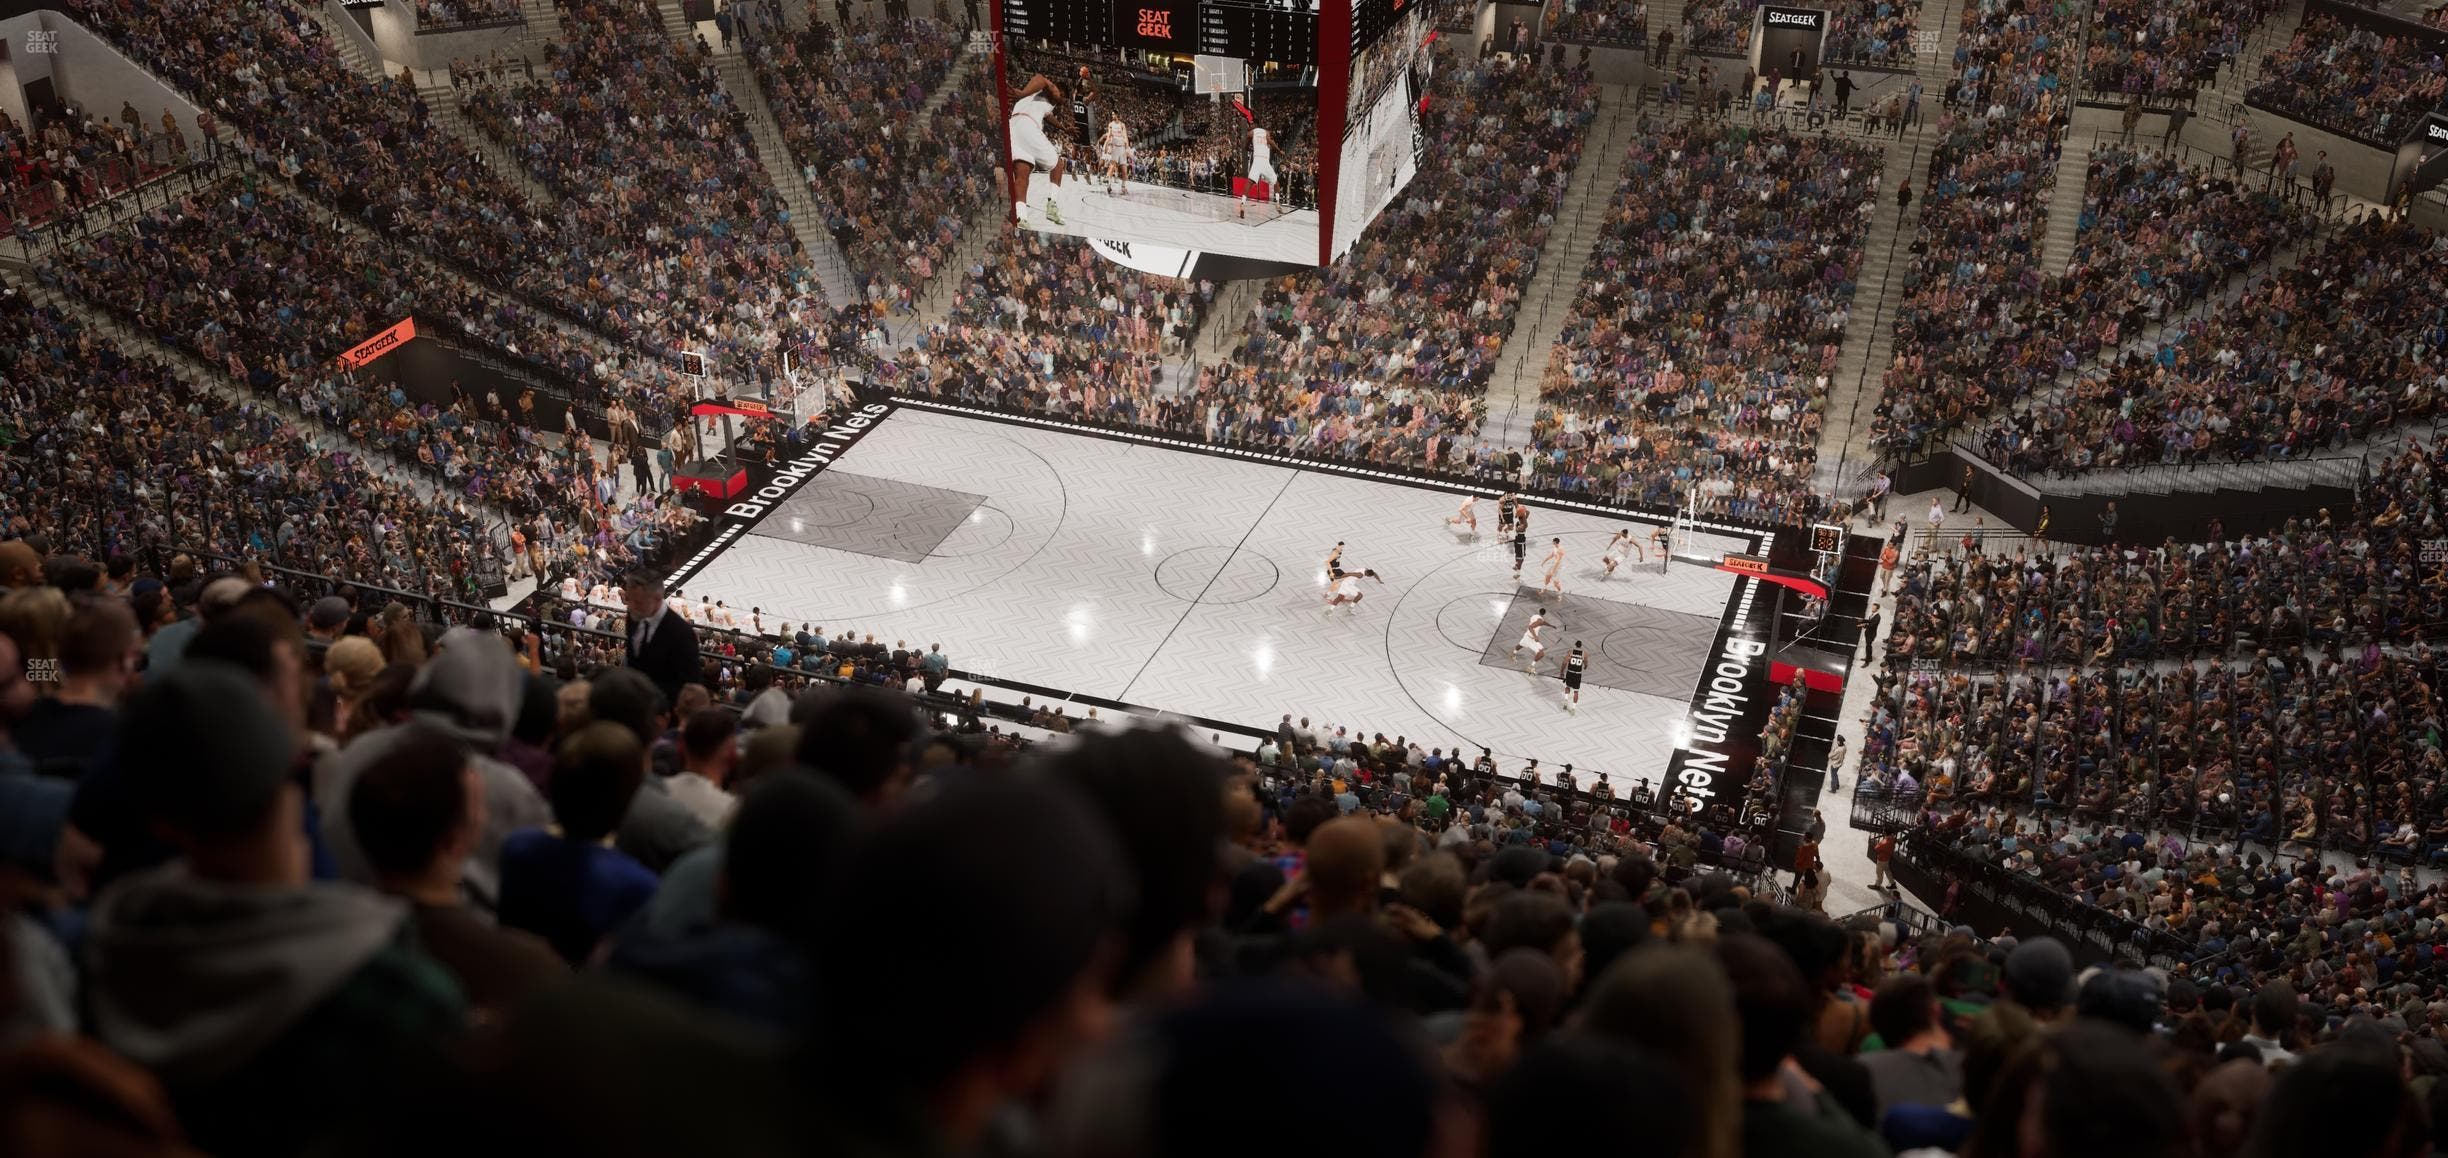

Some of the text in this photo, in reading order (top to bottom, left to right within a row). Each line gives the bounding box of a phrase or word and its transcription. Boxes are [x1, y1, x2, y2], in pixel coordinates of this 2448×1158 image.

[1139, 8, 1171, 24] SEAT
[1769, 11, 1817, 27] SEATGEEK
[1137, 23, 1172, 39] GEEK
[1074, 104, 1085, 113] 00
[2429, 124, 2448, 140] SEAT
[354, 329, 399, 361] SEATGEEK
[723, 403, 889, 519] Brooklyn Nets
[1571, 657, 1583, 666] 00
[1689, 637, 1766, 744] Brooklyn
[1478, 764, 1491, 773] 00
[1521, 771, 1533, 781] 00
[1557, 781, 1569, 790] 00
[1596, 791, 1609, 800] 00
[1754, 816, 1767, 826] 00
